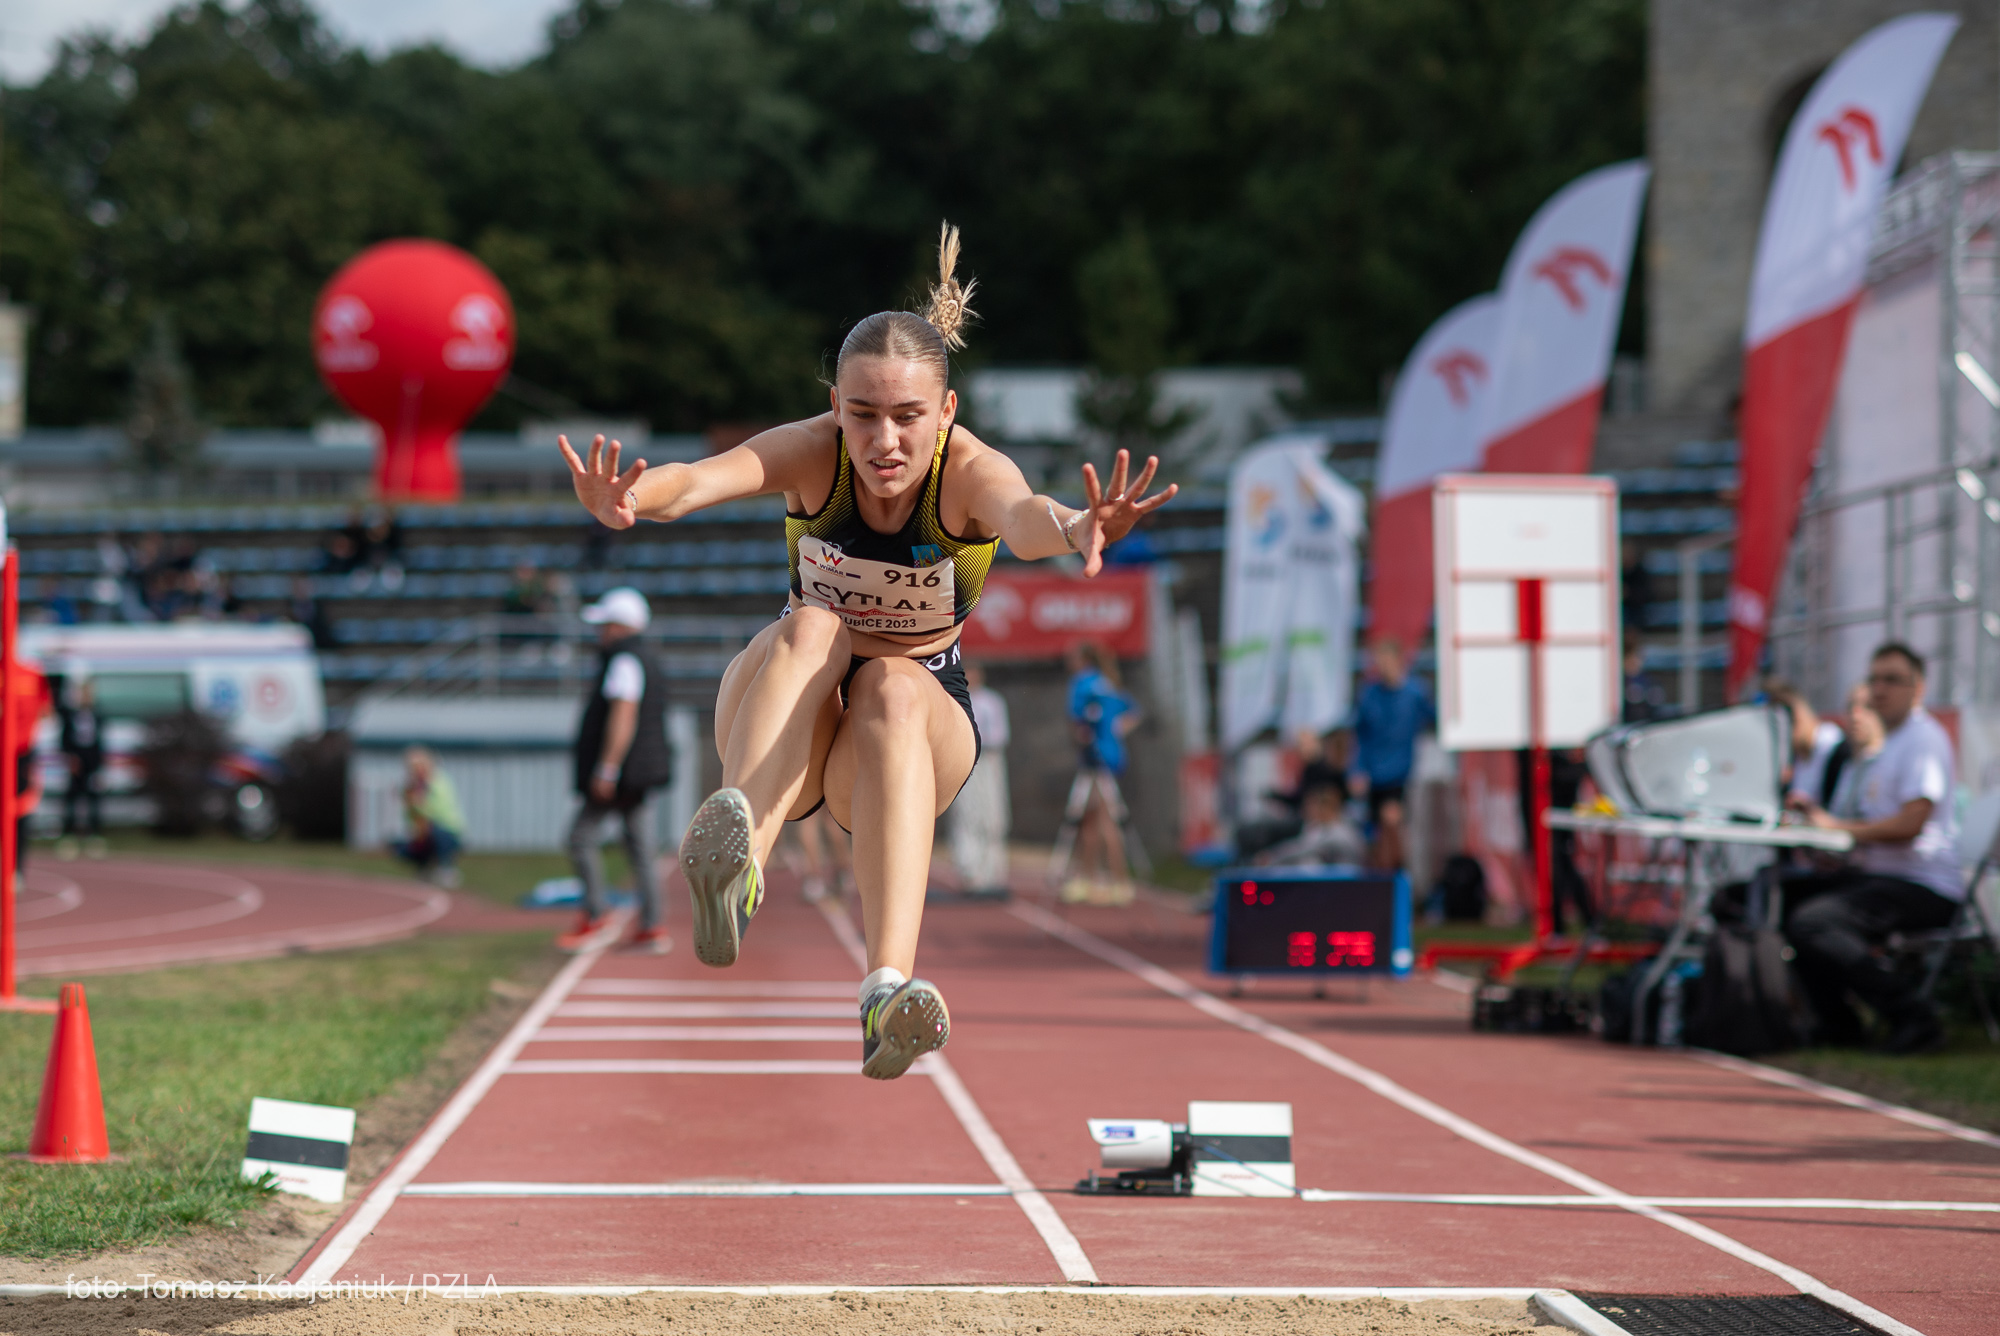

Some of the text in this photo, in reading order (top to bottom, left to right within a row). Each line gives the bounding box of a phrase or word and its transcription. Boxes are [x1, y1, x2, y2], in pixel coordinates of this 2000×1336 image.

[819, 563, 844, 576] WIMAR
[884, 569, 941, 588] 916
[812, 581, 936, 611] CYTLAŁ
[838, 614, 882, 629] UBICE
[885, 618, 917, 629] 2023
